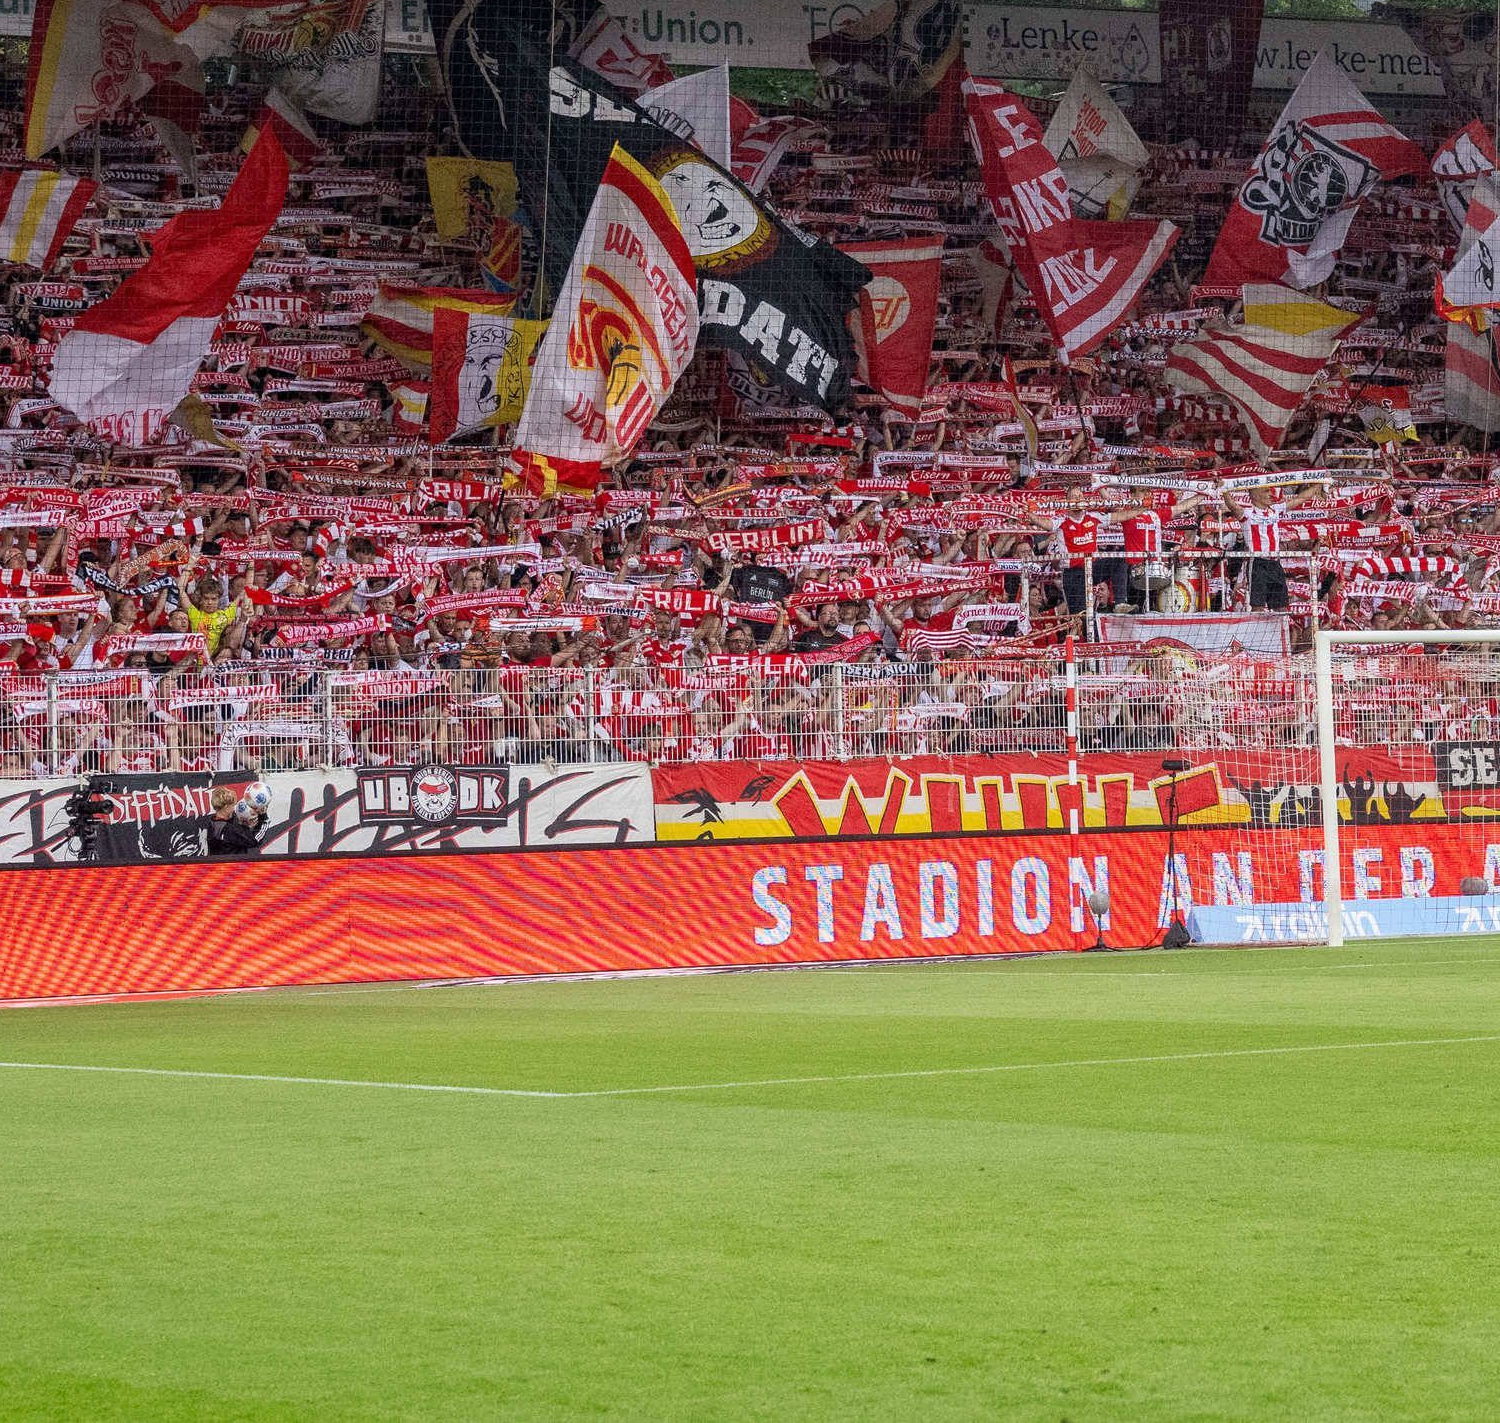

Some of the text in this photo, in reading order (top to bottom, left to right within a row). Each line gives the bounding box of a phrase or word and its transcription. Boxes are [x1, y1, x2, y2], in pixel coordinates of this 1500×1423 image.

[1001, 17, 1099, 53] Lenke
[749, 587, 775, 600] BERLIN
[109, 634, 139, 651] SEIT
[363, 776, 505, 812] UB DK
[752, 855, 1111, 947] STADION
[1157, 850, 1254, 931] AN
